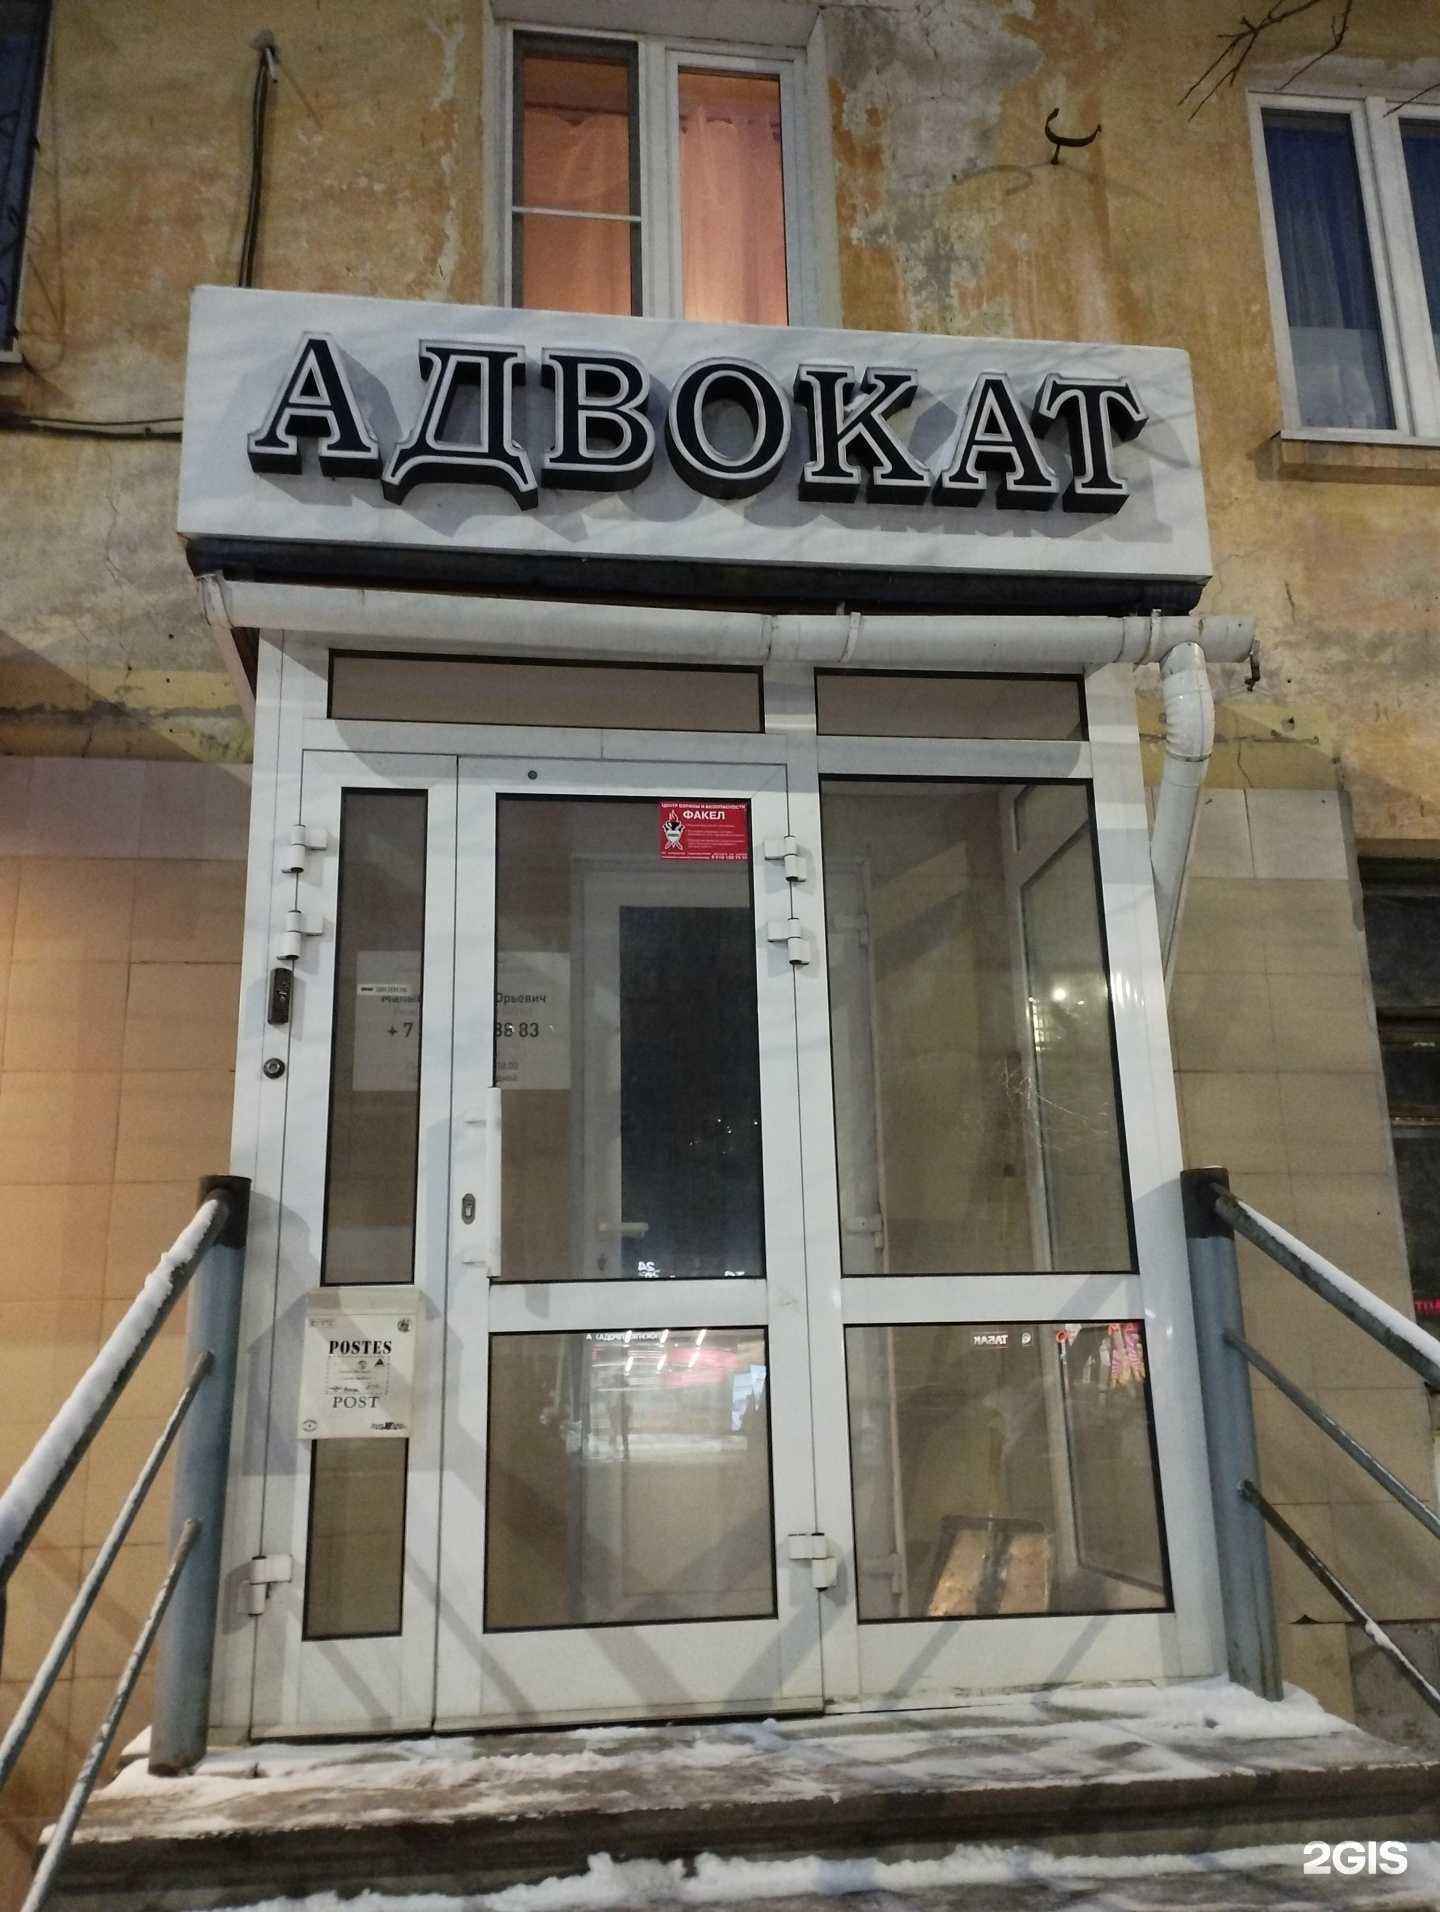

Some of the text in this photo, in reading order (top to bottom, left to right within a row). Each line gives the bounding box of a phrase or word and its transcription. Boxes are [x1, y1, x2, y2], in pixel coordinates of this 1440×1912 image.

[247, 331, 1149, 512] АДВОКАТ
[682, 809, 726, 820] ФАКЕЛ
[519, 1022, 540, 1038] 83
[328, 1340, 392, 1355] POSTES
[332, 1396, 380, 1409] POST
